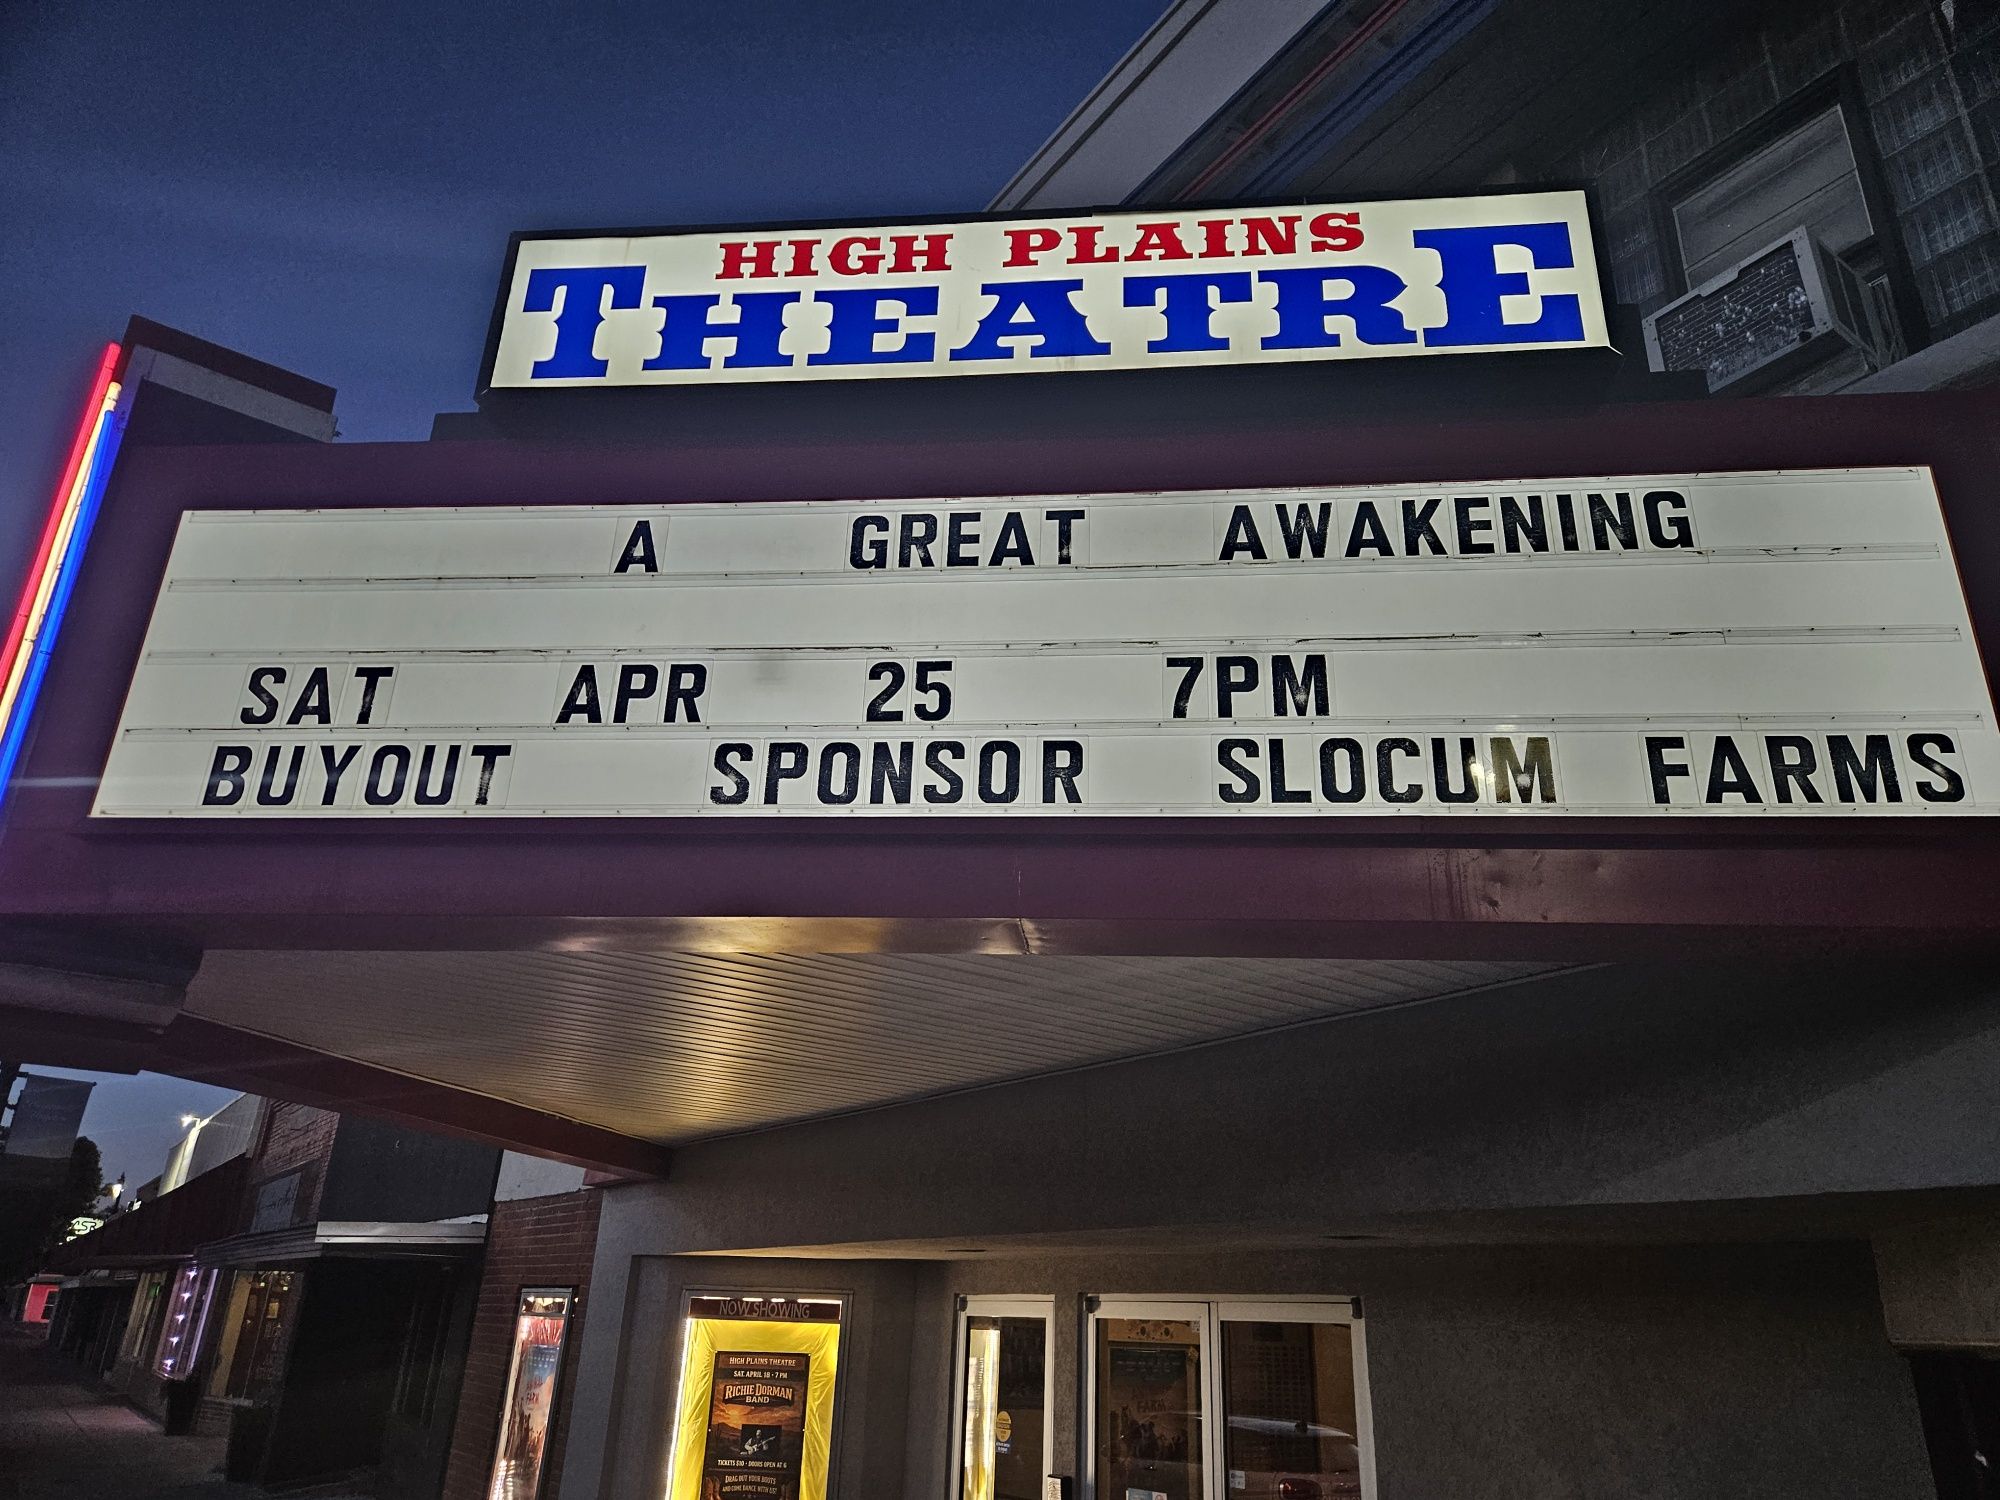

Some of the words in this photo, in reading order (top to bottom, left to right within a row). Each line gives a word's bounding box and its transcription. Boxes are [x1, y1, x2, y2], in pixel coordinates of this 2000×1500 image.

[715, 233, 954, 280] HIGH
[1002, 212, 1365, 268] PLAINS
[522, 221, 1586, 379] THEATRE
[613, 519, 659, 574] A
[849, 509, 1086, 570] GREAT
[1218, 490, 1694, 561] AWAKENING
[239, 666, 394, 725] SAT
[554, 664, 708, 724] APR
[866, 660, 954, 723] 25
[1165, 653, 1331, 719] 7PM
[202, 744, 512, 806] BUYOUT
[710, 740, 1084, 806] SPONSOR
[1217, 736, 1557, 804] SLOCUM
[1644, 734, 1966, 804] FARMS
[720, 1300, 751, 1316] NOW
[753, 1302, 810, 1319] SHOWING
[729, 1357, 745, 1365] HIGH
[746, 1357, 768, 1366] PLAINS
[769, 1358, 796, 1367] THEATRE
[763, 1371, 771, 1379] 18
[724, 1384, 755, 1400] RICHIE
[755, 1383, 793, 1400] DORMAN
[745, 1395, 770, 1404] BAND
[717, 1459, 736, 1467] TICKETS
[748, 1460, 763, 1468] DOORS
[725, 1475, 738, 1483] DRAG
